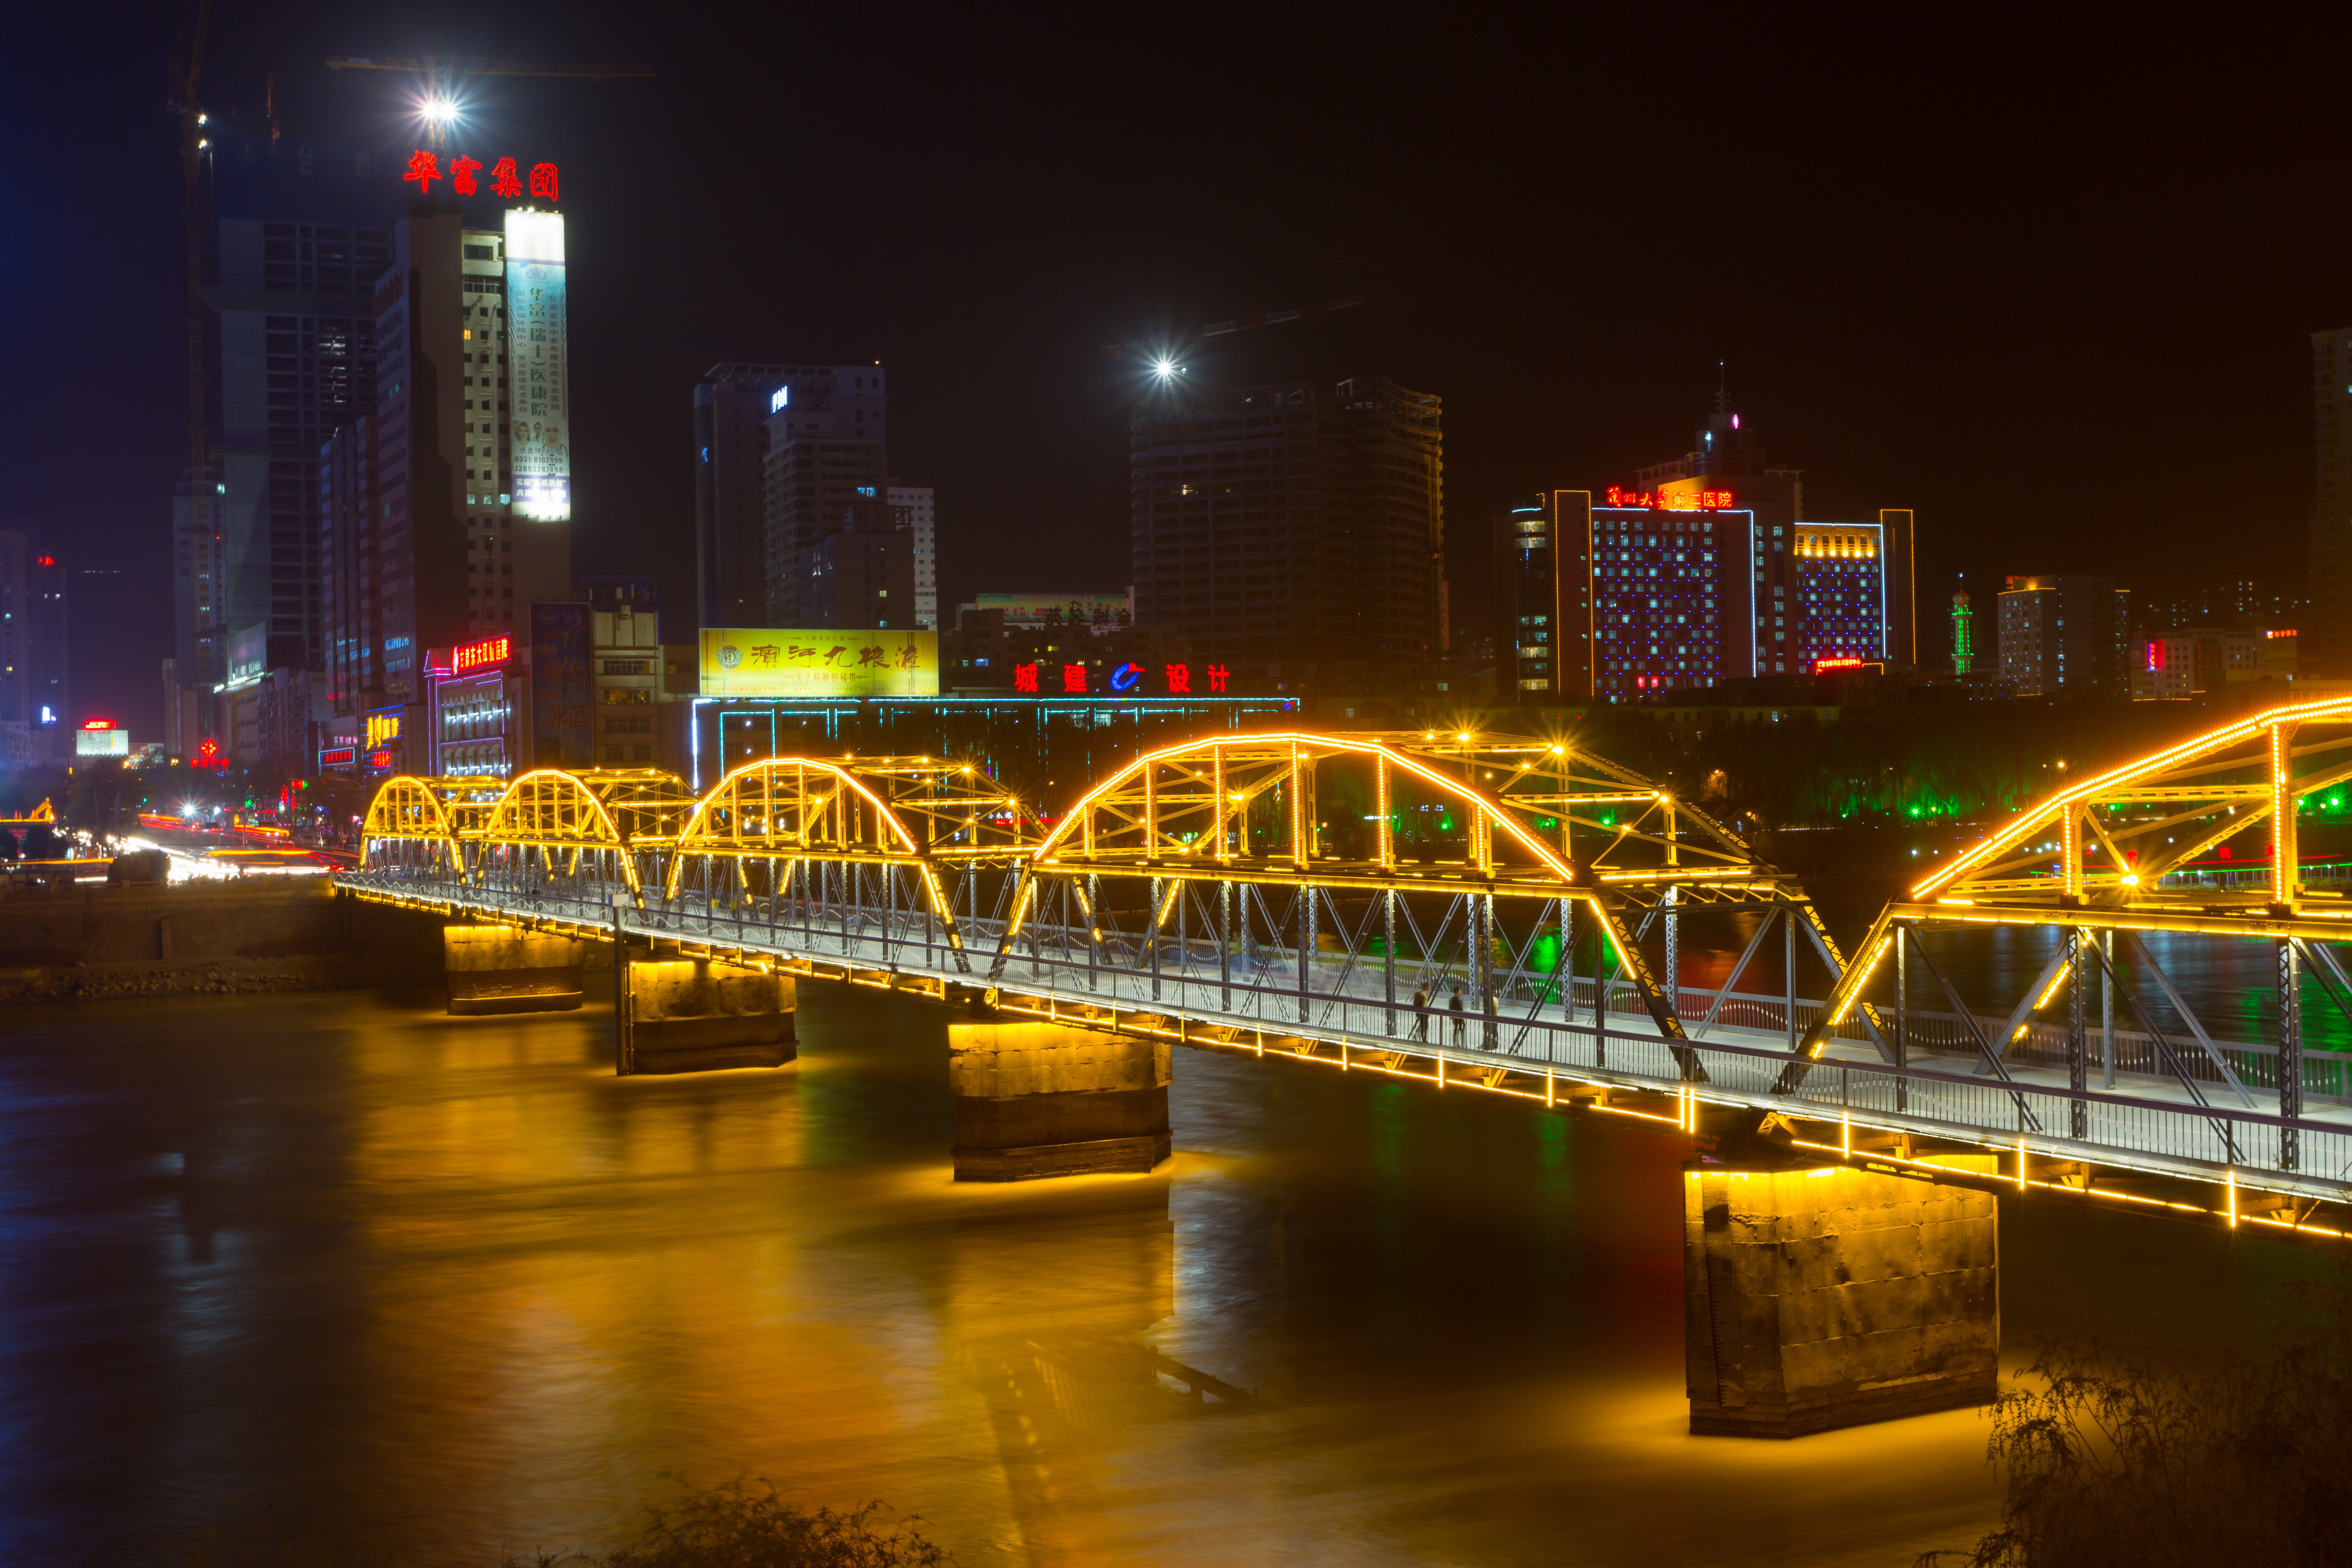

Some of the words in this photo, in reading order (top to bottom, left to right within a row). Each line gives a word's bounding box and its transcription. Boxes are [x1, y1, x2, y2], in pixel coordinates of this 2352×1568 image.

[404, 149, 558, 201] 华富集团
[516, 291, 527, 347] 国际高端体检中心
[549, 296, 560, 411] 甘肃首家中老年慢性病专业医院
[545, 659, 588, 685] 祁连
[796, 672, 856, 683] 无法超越的稀贵
[546, 704, 589, 729] 冰酒
